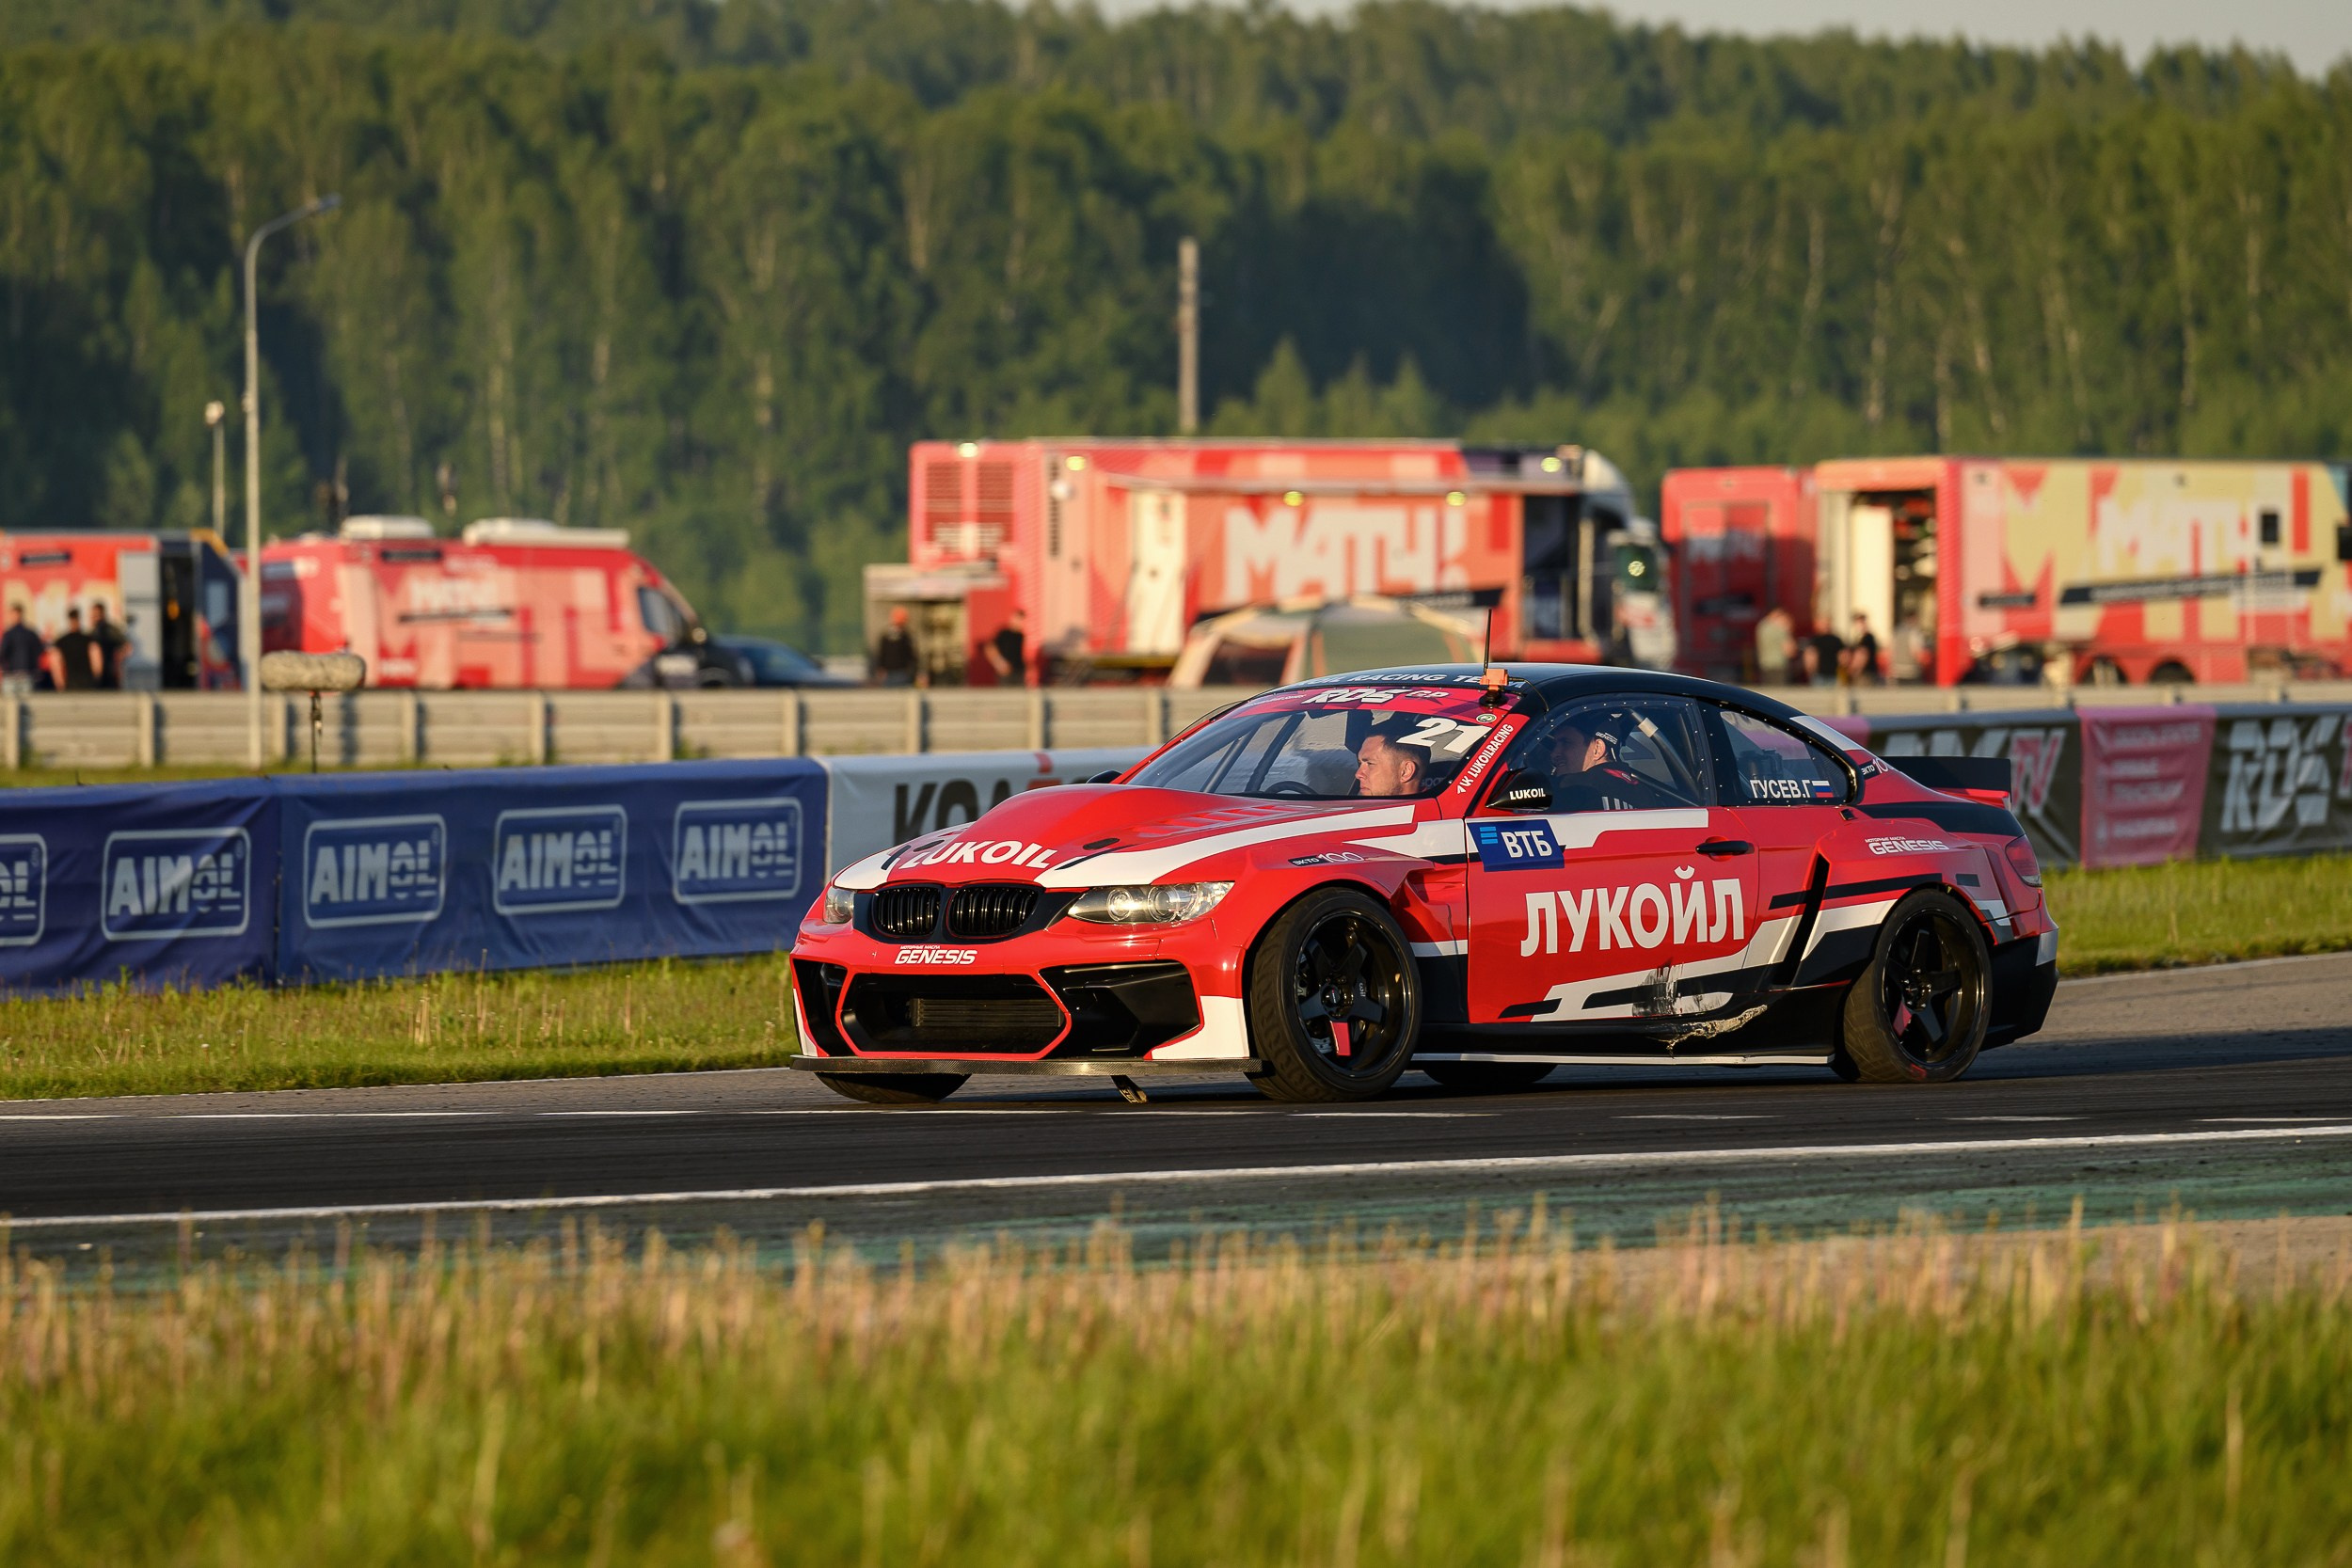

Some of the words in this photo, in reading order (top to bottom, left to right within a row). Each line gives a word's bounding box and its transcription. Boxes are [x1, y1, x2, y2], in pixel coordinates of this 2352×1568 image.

[1346, 673, 1447, 683] RACING
[1453, 674, 1526, 689] TEM
[1301, 689, 1408, 704] RDS
[1395, 717, 1494, 753] 21
[1469, 723, 1514, 779] LUKOILRACING
[1872, 757, 1893, 773] 10
[1509, 787, 1546, 800] LUKOIL
[1750, 779, 1811, 799] ГУСЕВ.Г
[678, 821, 795, 881] AIMOL
[898, 840, 1058, 870] LUKOIL
[1317, 851, 1365, 863] 100
[1501, 830, 1553, 858] ВТБ
[1868, 840, 1950, 855] GENESIS
[310, 839, 437, 904] AIMOL
[499, 830, 618, 892] AIMOL
[107, 853, 242, 915] AIMOL
[1520, 864, 1745, 958] ЛУКОЙЛ
[894, 949, 978, 965] GENESIS
